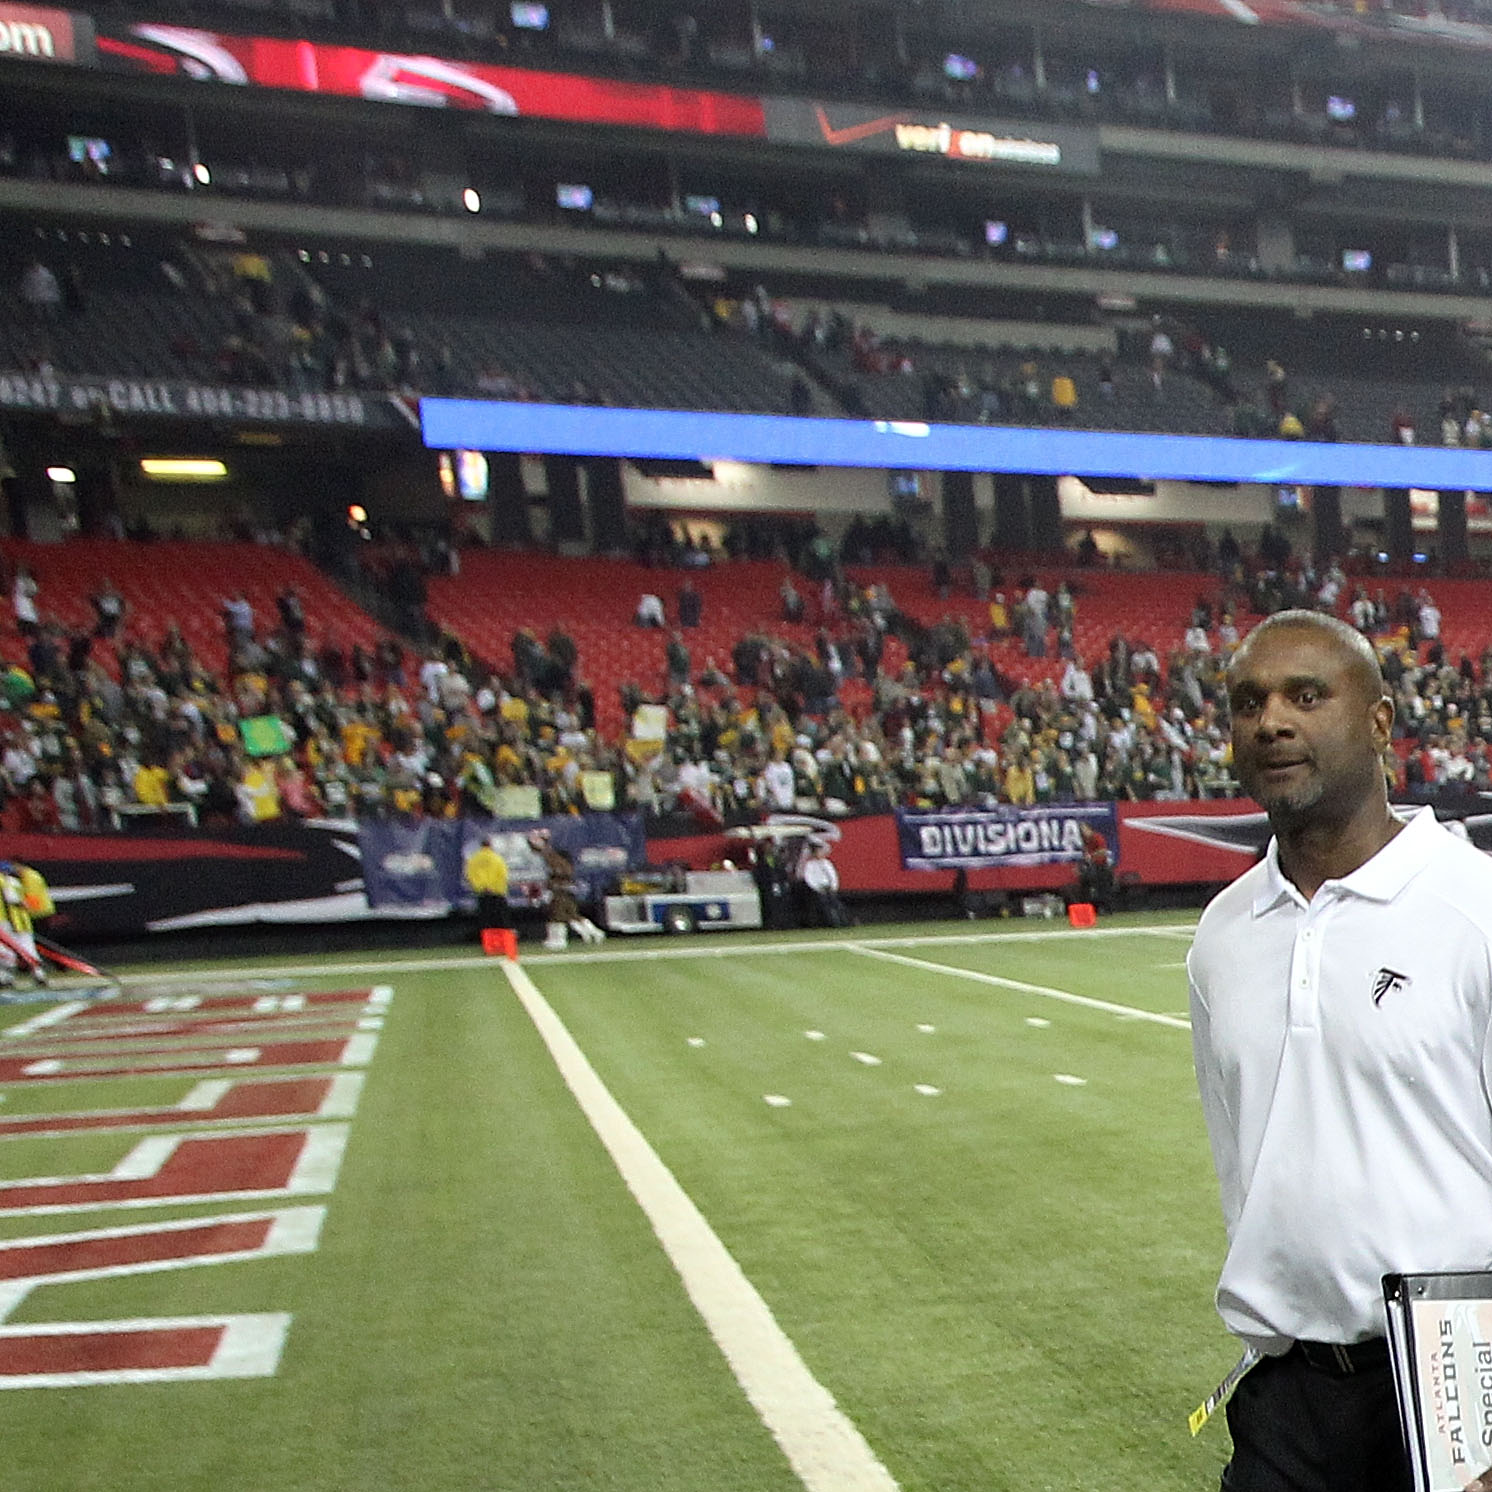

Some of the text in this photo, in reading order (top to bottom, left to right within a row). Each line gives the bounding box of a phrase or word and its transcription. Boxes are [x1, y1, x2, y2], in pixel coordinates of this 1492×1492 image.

[920, 819, 1085, 858] DIVISIONA
[1431, 1352, 1447, 1434] ATLANTA
[1439, 1320, 1466, 1466] FALCONS
